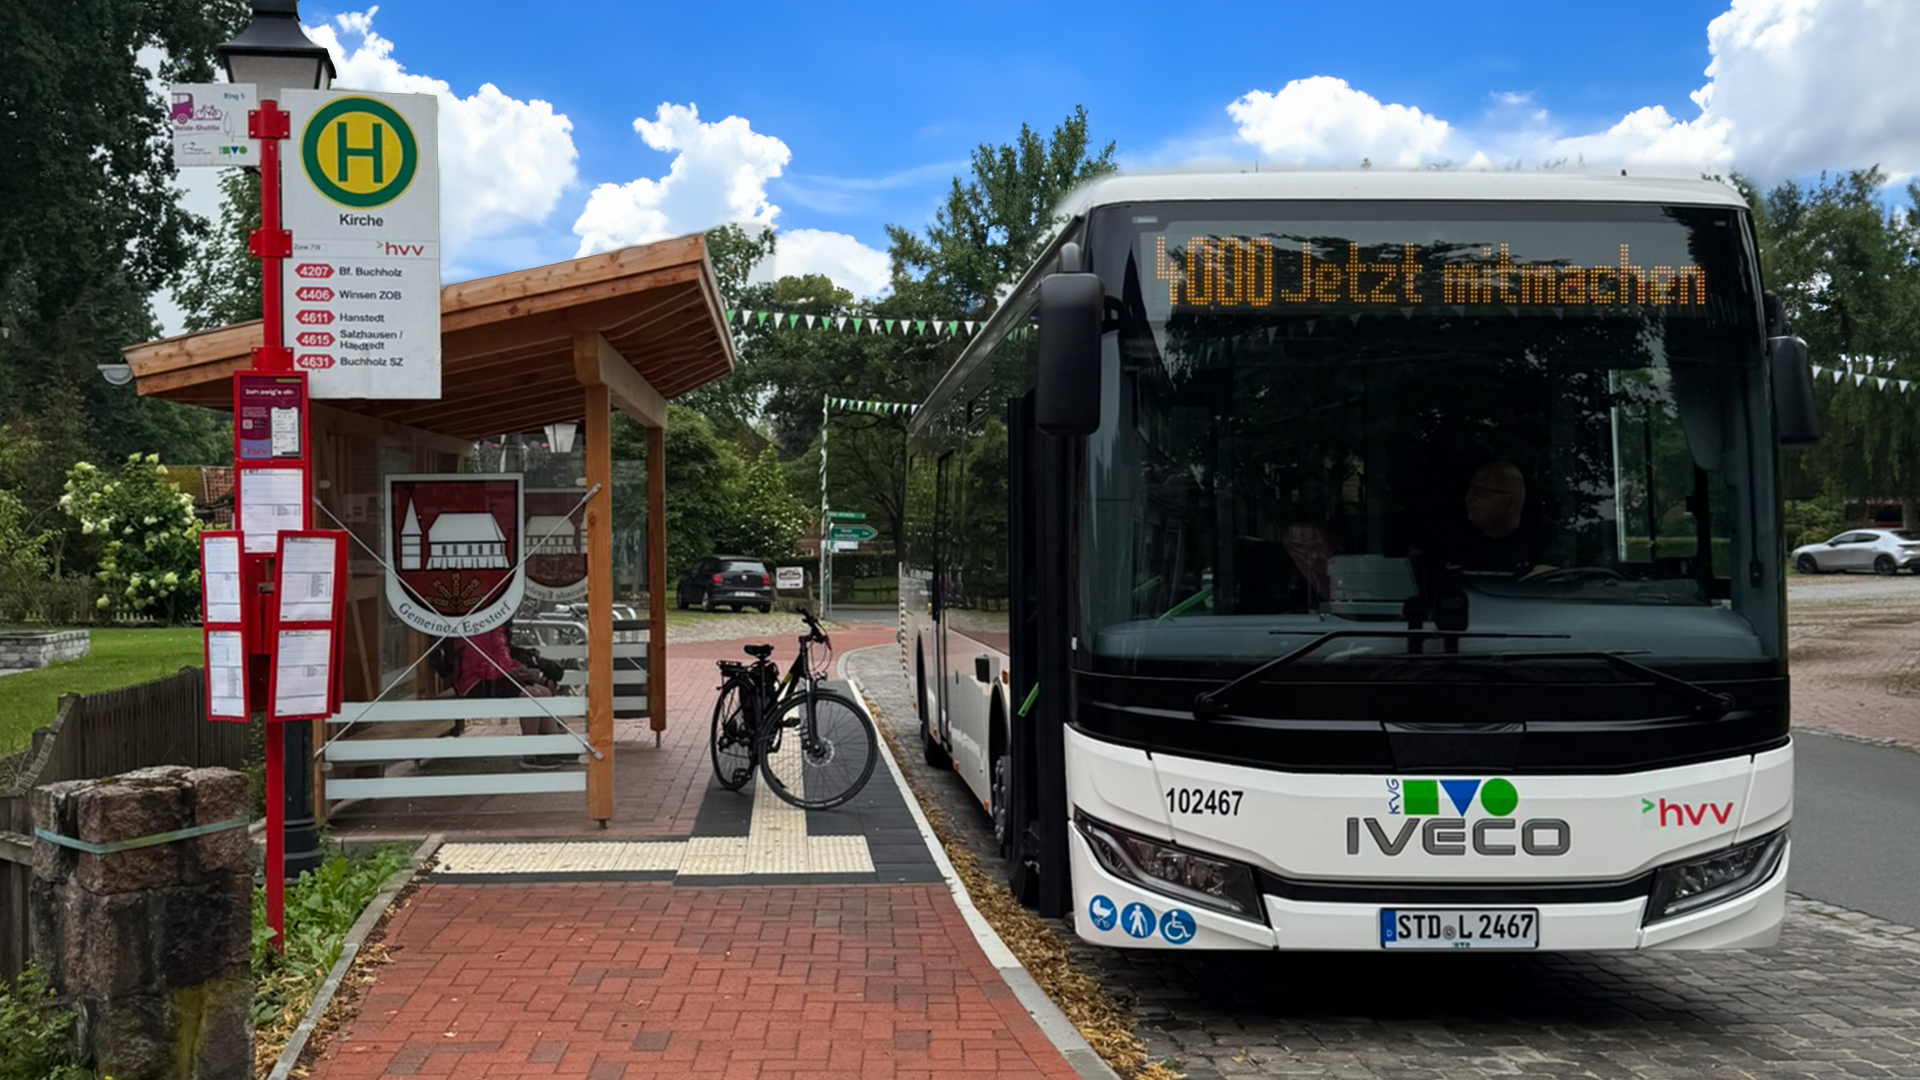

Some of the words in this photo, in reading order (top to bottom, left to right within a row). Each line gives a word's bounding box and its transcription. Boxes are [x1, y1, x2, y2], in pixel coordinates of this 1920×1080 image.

[337, 121, 384, 184] H
[339, 213, 384, 228] Kirche
[385, 242, 425, 256] hvv
[300, 266, 329, 277] 4207
[339, 266, 352, 276] Bf.
[355, 266, 403, 277] Buchholz
[1156, 236, 1273, 307] 4000
[1281, 242, 1423, 304] Jetzt
[1442, 242, 1707, 306] mitmachen
[300, 289, 330, 300] 4406
[339, 289, 377, 300] Winsen
[379, 290, 402, 300] ZOB
[301, 312, 329, 323] 4611
[340, 313, 385, 323] Hanstedt
[301, 334, 330, 345] 4615
[340, 329, 397, 339] Salzhausen
[301, 356, 329, 367] 4631
[340, 356, 387, 367] Buchholz
[389, 357, 404, 367] SZ
[462, 600, 512, 634] Egestorf
[1165, 787, 1244, 816] 102467
[1385, 778, 1400, 815] KVG
[1659, 798, 1734, 827] hvv
[1346, 817, 1571, 857] IVECO
[1398, 914, 1441, 939] STD
[1459, 914, 1473, 939] L
[1479, 914, 1534, 939] 2467
